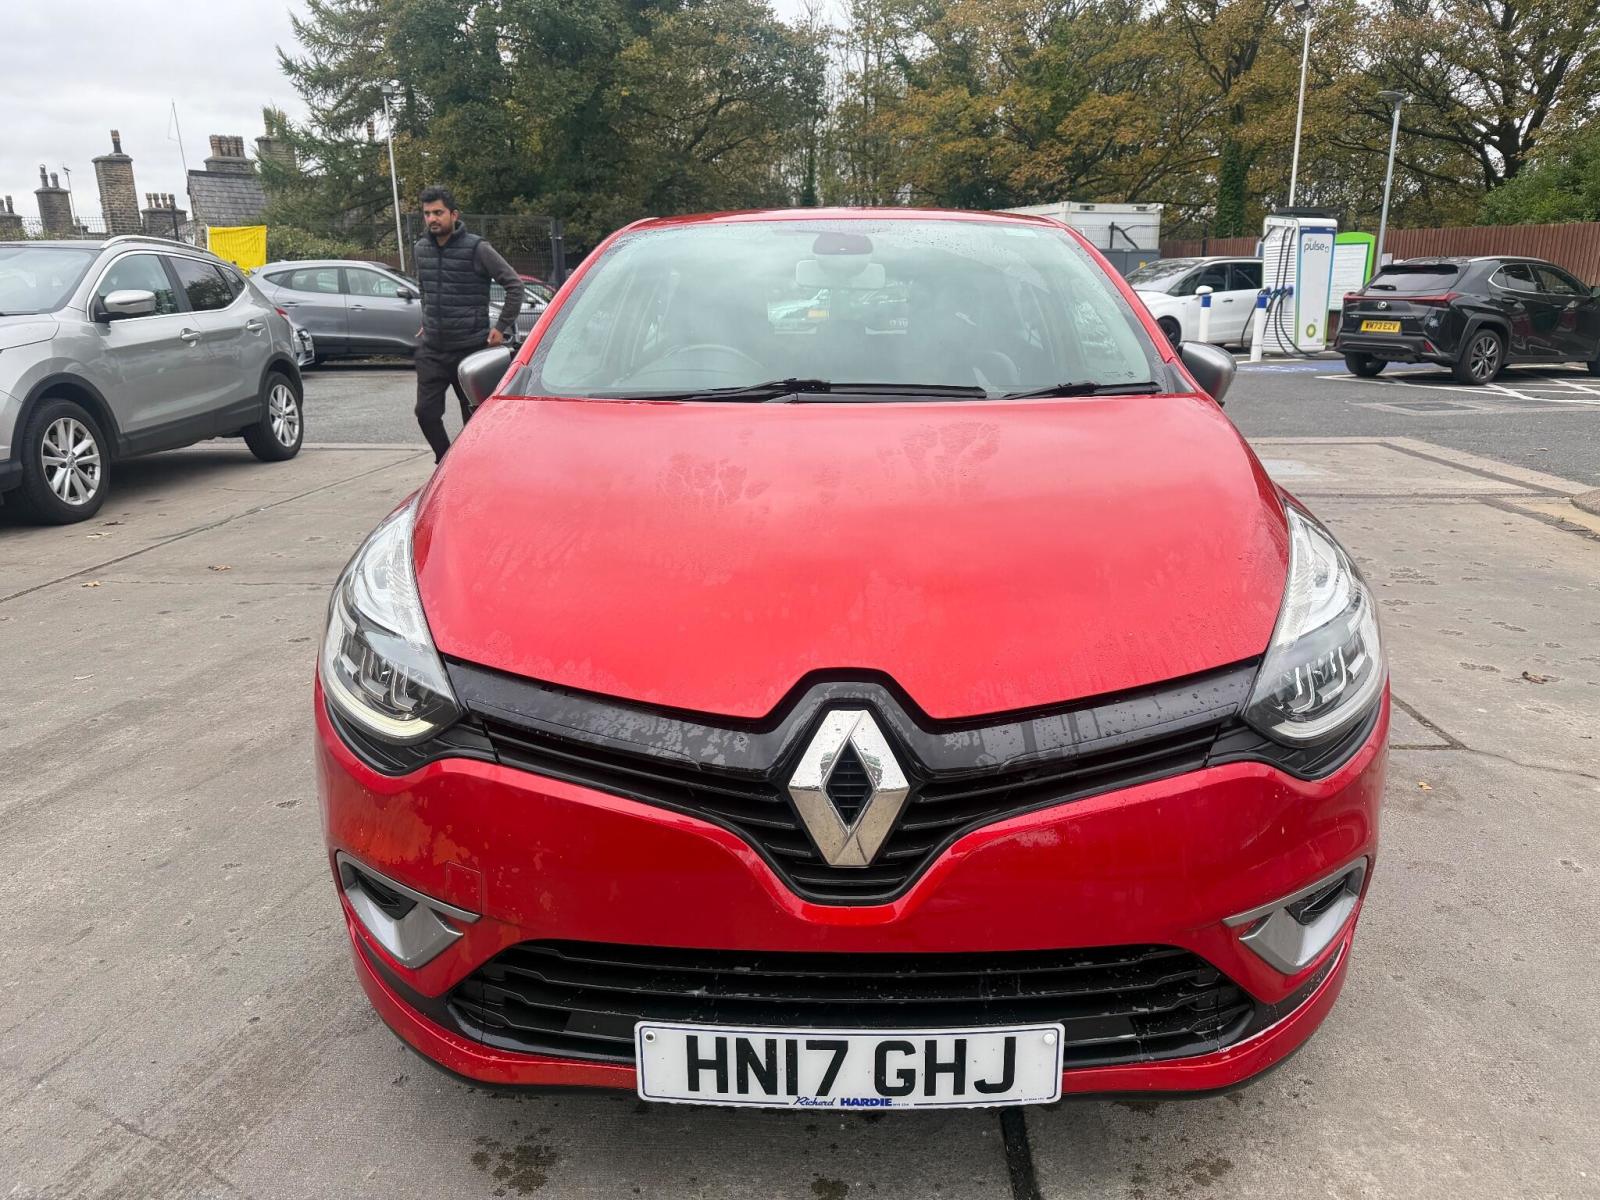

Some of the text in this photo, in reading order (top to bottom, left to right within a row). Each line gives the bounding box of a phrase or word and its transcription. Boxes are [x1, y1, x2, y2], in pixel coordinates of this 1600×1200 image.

[1304, 240, 1325, 254] pulse
[686, 1035, 1016, 1096] HN17 GHJ
[793, 1096, 836, 1107] Richard
[840, 1098, 892, 1107] HARDIE
